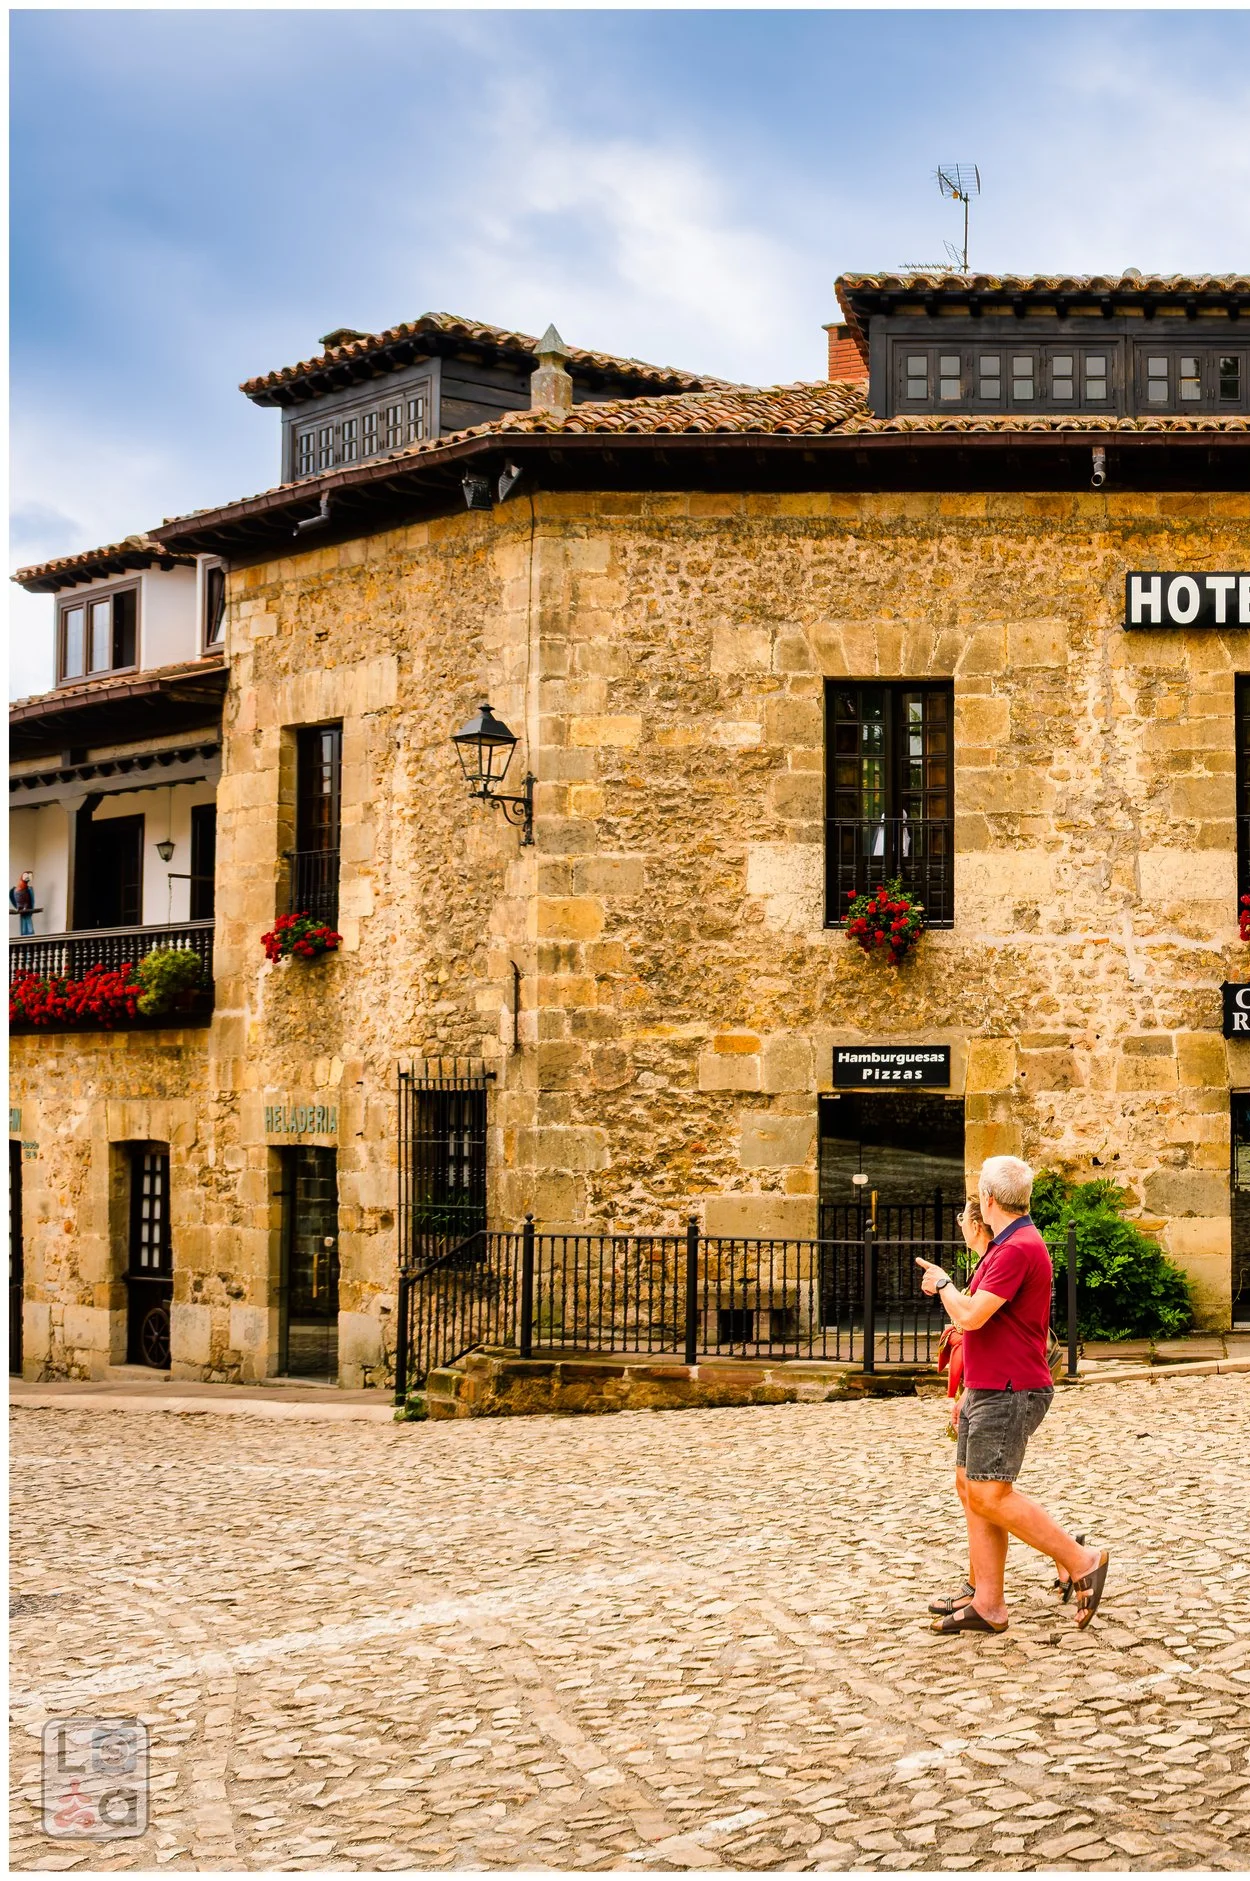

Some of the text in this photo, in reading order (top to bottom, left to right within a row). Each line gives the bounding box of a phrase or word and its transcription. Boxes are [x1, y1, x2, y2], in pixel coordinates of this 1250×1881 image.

[838, 1052, 945, 1065] Hamburguesas
[862, 1068, 923, 1080] Pizzas
[265, 1104, 338, 1133] HELADERIA
